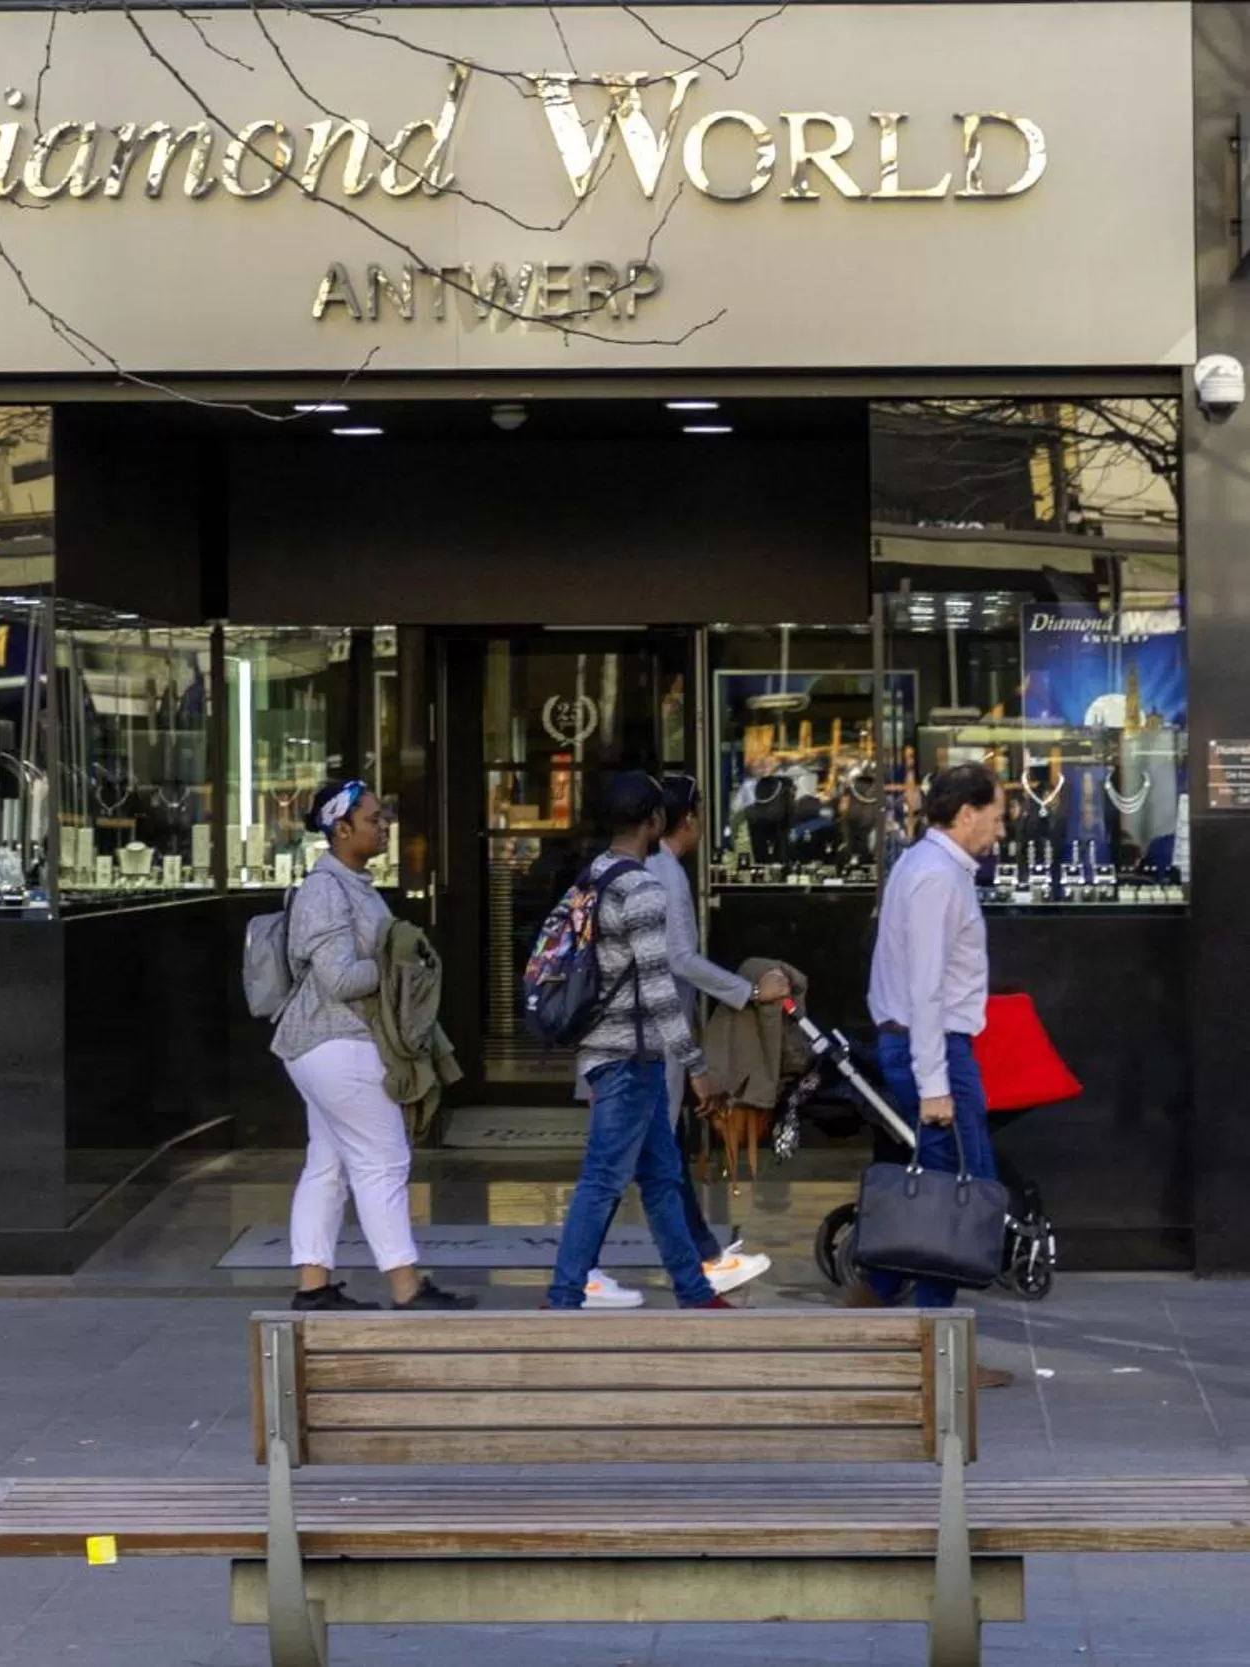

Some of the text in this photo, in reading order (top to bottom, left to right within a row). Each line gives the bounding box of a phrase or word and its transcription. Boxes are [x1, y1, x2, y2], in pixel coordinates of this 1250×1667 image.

[529, 70, 1048, 202] WORLD
[311, 260, 664, 321] ANTWERP
[1029, 612, 1115, 632] Diamond
